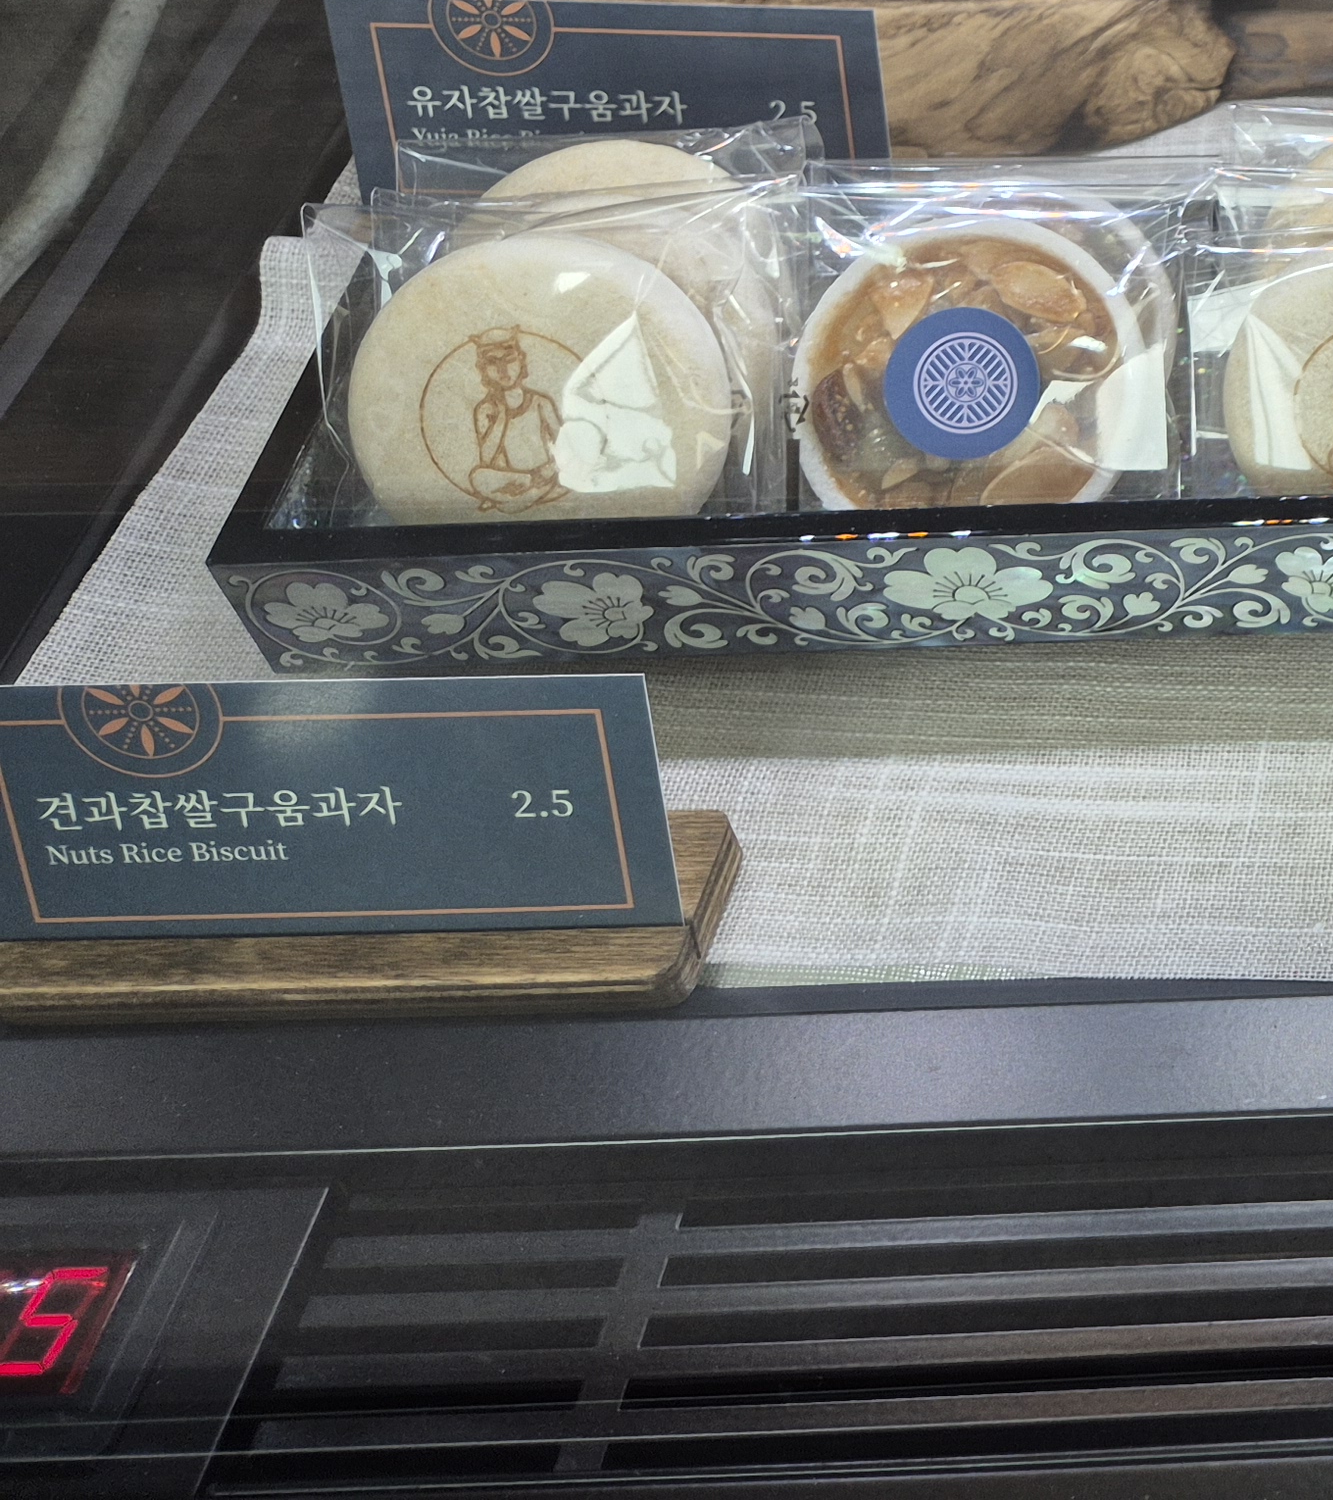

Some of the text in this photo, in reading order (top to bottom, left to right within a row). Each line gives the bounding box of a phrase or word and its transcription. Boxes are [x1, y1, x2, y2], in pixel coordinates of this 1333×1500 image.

[406, 85, 688, 125] 유자찹쌀구움과자
[768, 99, 818, 126] 25
[36, 785, 403, 832] 견과찹쌀구움과자
[511, 789, 575, 818] 2.5
[45, 838, 289, 866] Nuts Rice Biscuit
